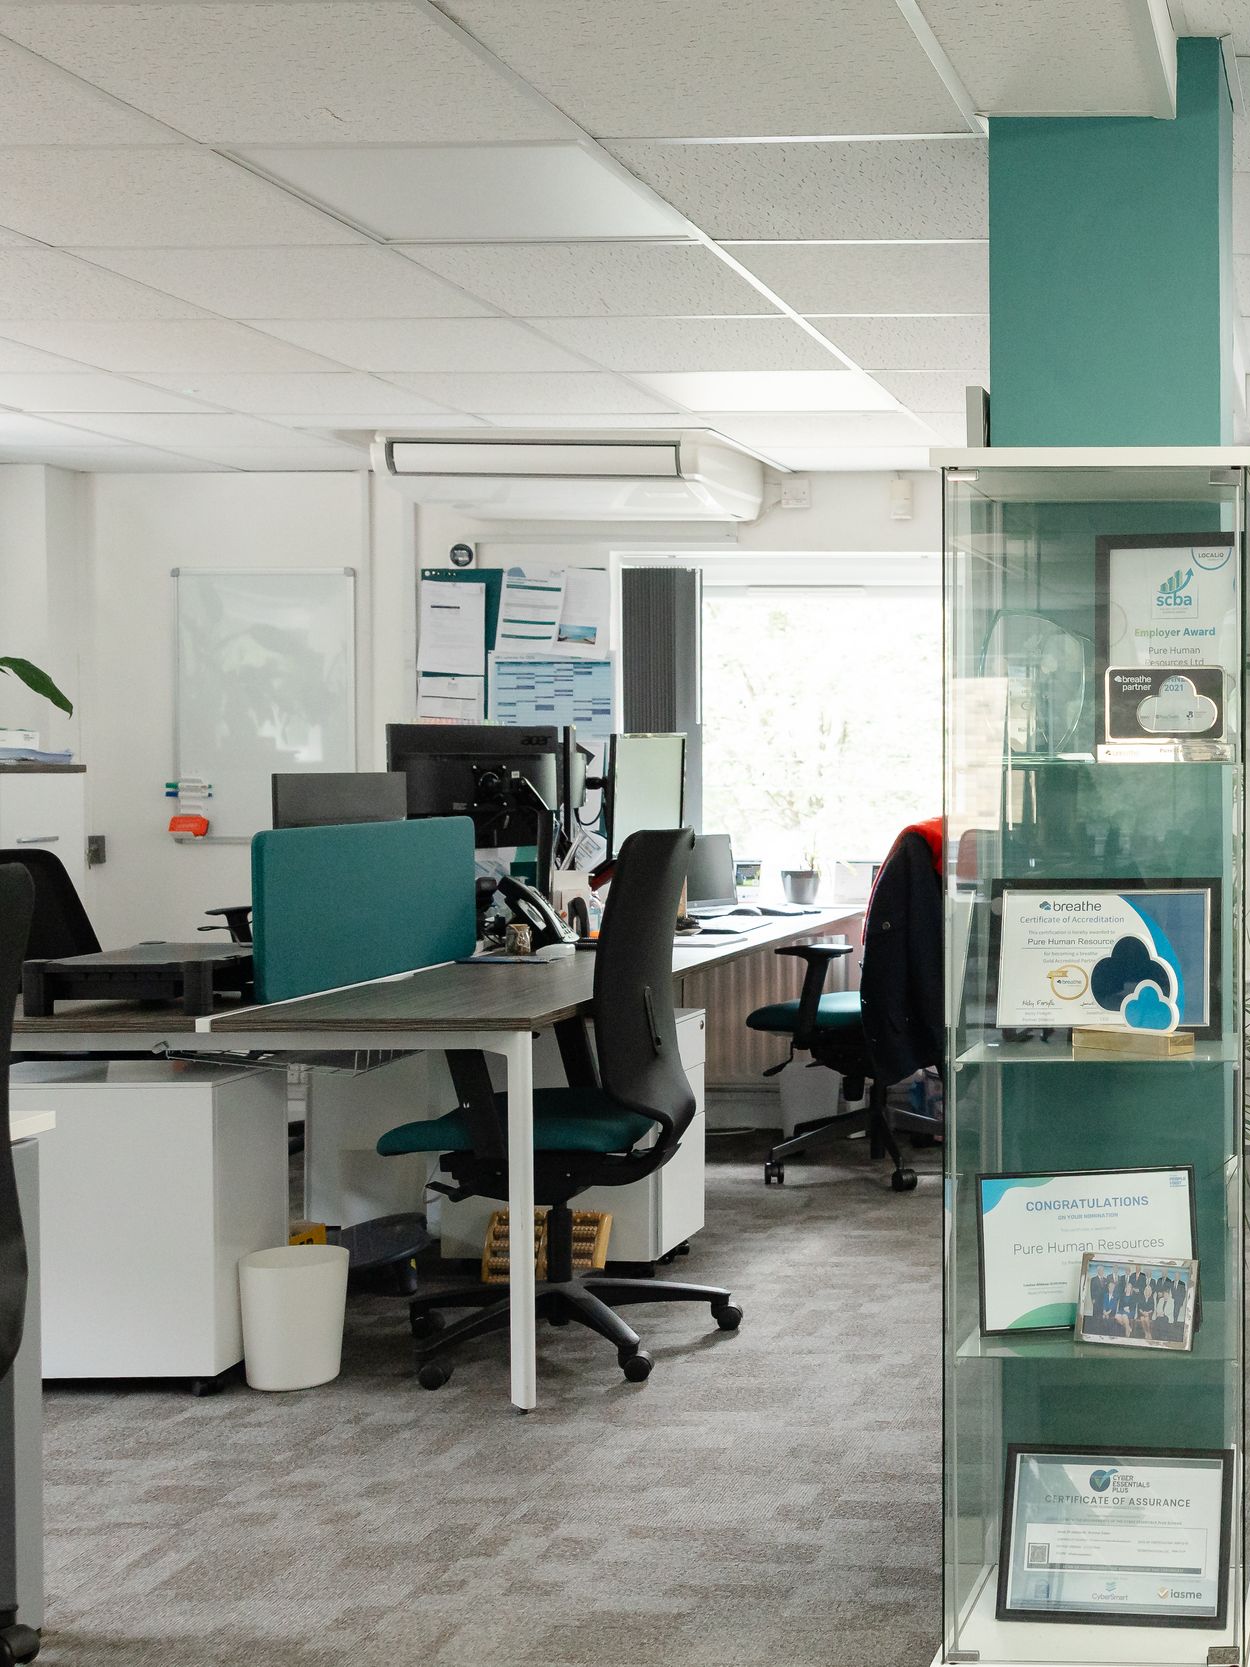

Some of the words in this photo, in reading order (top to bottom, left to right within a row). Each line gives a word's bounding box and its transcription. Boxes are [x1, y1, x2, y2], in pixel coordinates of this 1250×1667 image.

[1156, 591, 1193, 607] scba
[1135, 628, 1181, 639] Employer
[1183, 627, 1216, 637] Award
[1148, 647, 1168, 655] Pure
[1169, 647, 1201, 655] Human
[1122, 675, 1152, 683] breathe
[1122, 684, 1152, 692] partner
[1164, 684, 1184, 692] 2021
[521, 735, 553, 746] acer
[1053, 900, 1102, 912] breathe
[1020, 916, 1061, 924] Certificate
[1062, 916, 1071, 924] of
[1071, 916, 1125, 924] Accreditation
[1027, 938, 1046, 946] Pure
[1048, 938, 1076, 946] Human
[1077, 938, 1115, 946] Resource
[1025, 1195, 1150, 1212] CONGRATULATIONS
[1013, 1243, 1044, 1256] Pure
[1048, 1241, 1094, 1254] Human
[1098, 1238, 1165, 1251] Resources
[1044, 1494, 1110, 1505] CERTIFICATE
[1112, 1497, 1126, 1505] OF
[1128, 1497, 1191, 1508] ASSURANCE
[1091, 1592, 1128, 1601] CyberSmart
[1170, 1589, 1203, 1600] iasme
